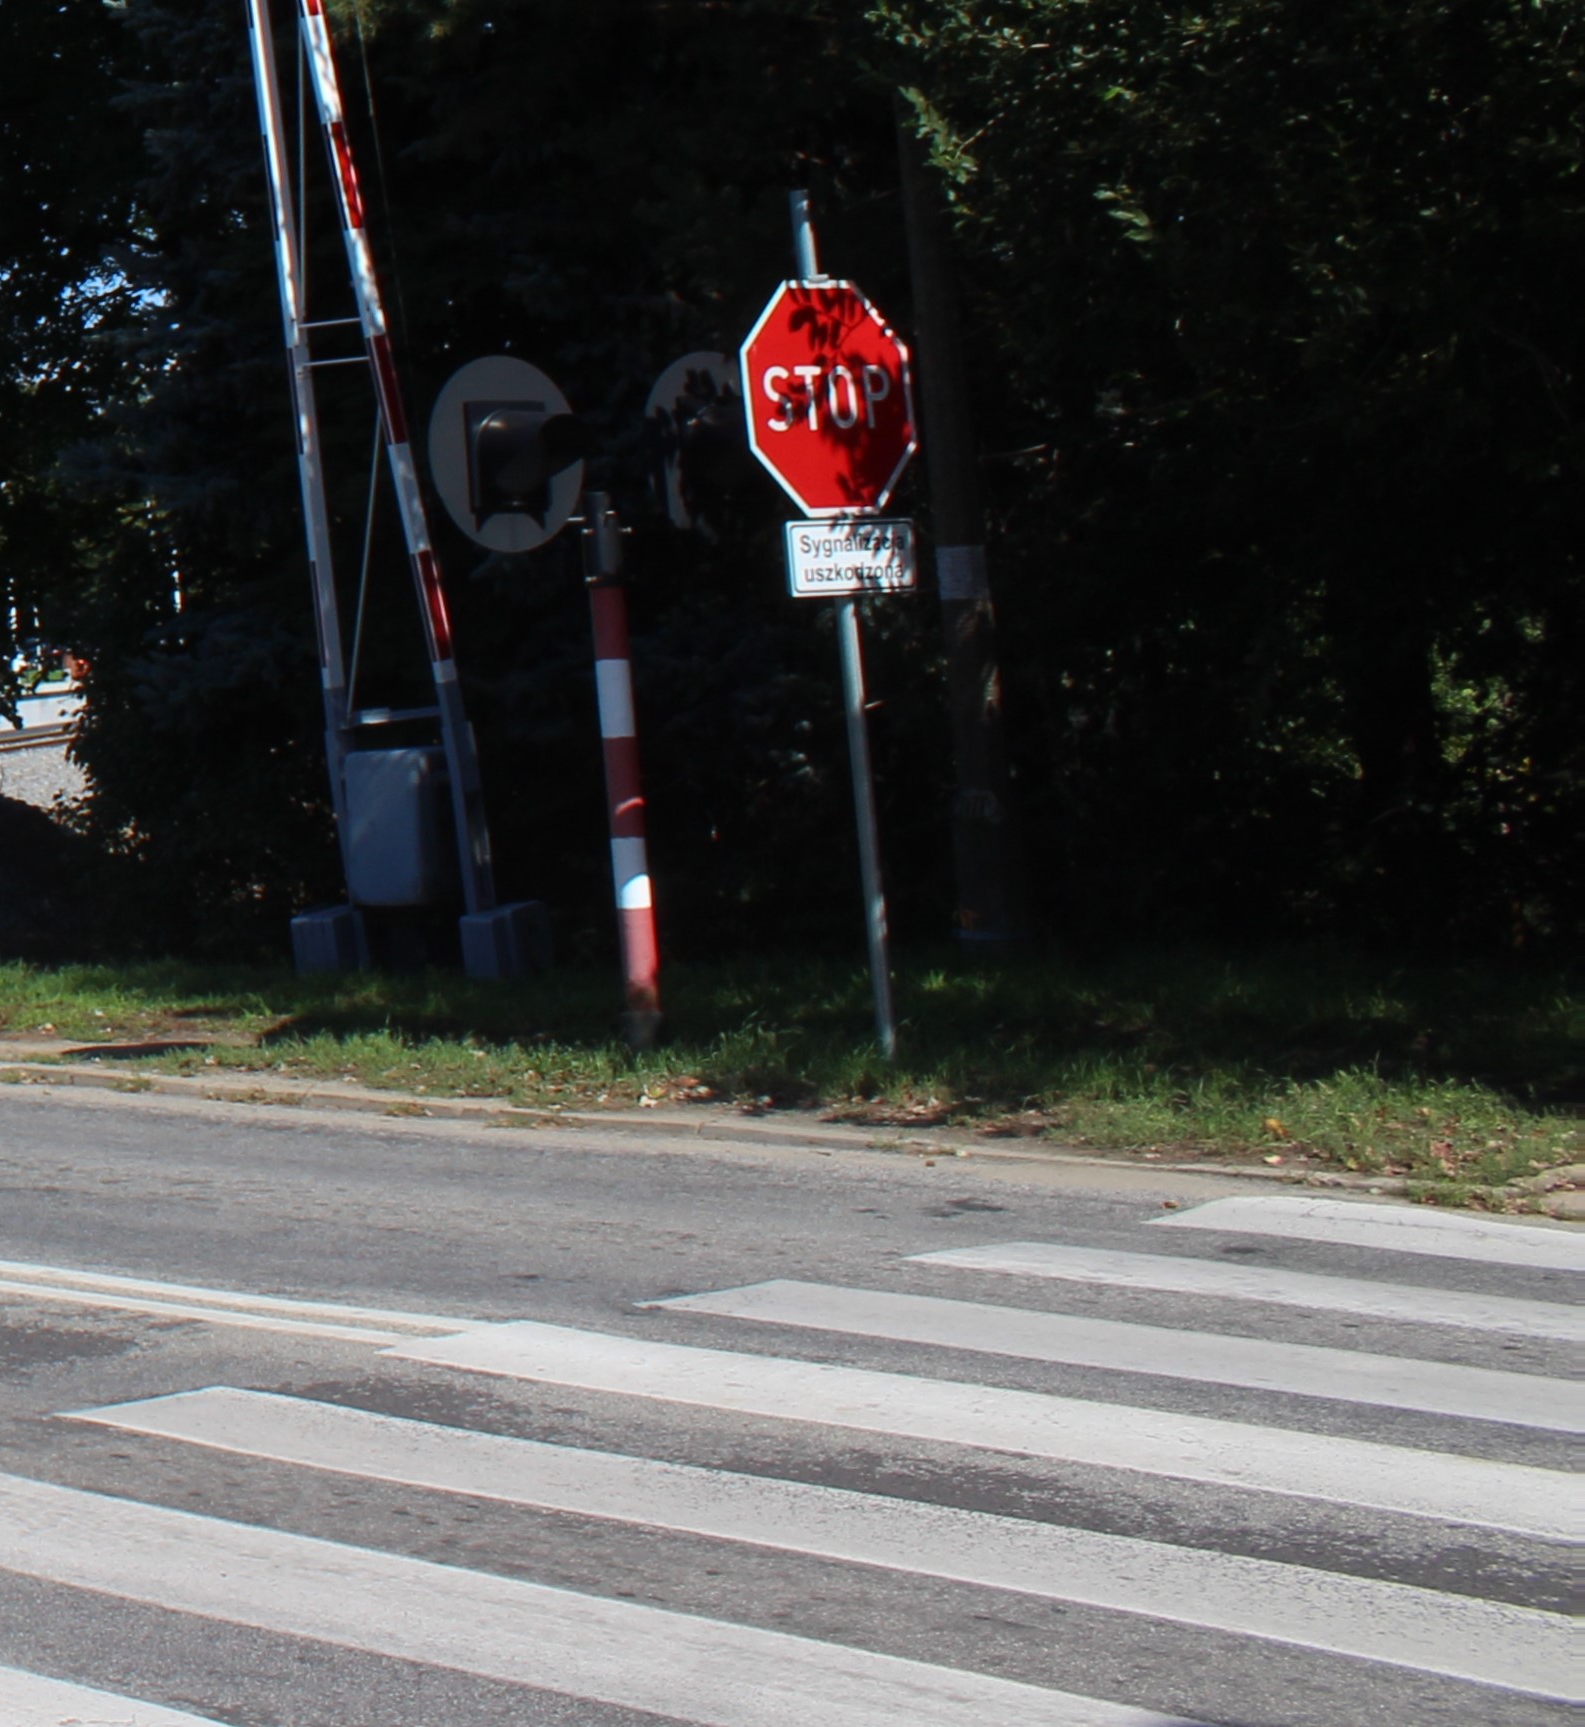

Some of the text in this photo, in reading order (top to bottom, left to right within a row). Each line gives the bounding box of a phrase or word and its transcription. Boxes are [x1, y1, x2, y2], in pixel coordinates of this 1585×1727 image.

[762, 364, 890, 432] STOP
[799, 532, 905, 558] Sygnalizacja
[803, 561, 905, 582] uszkodzona
